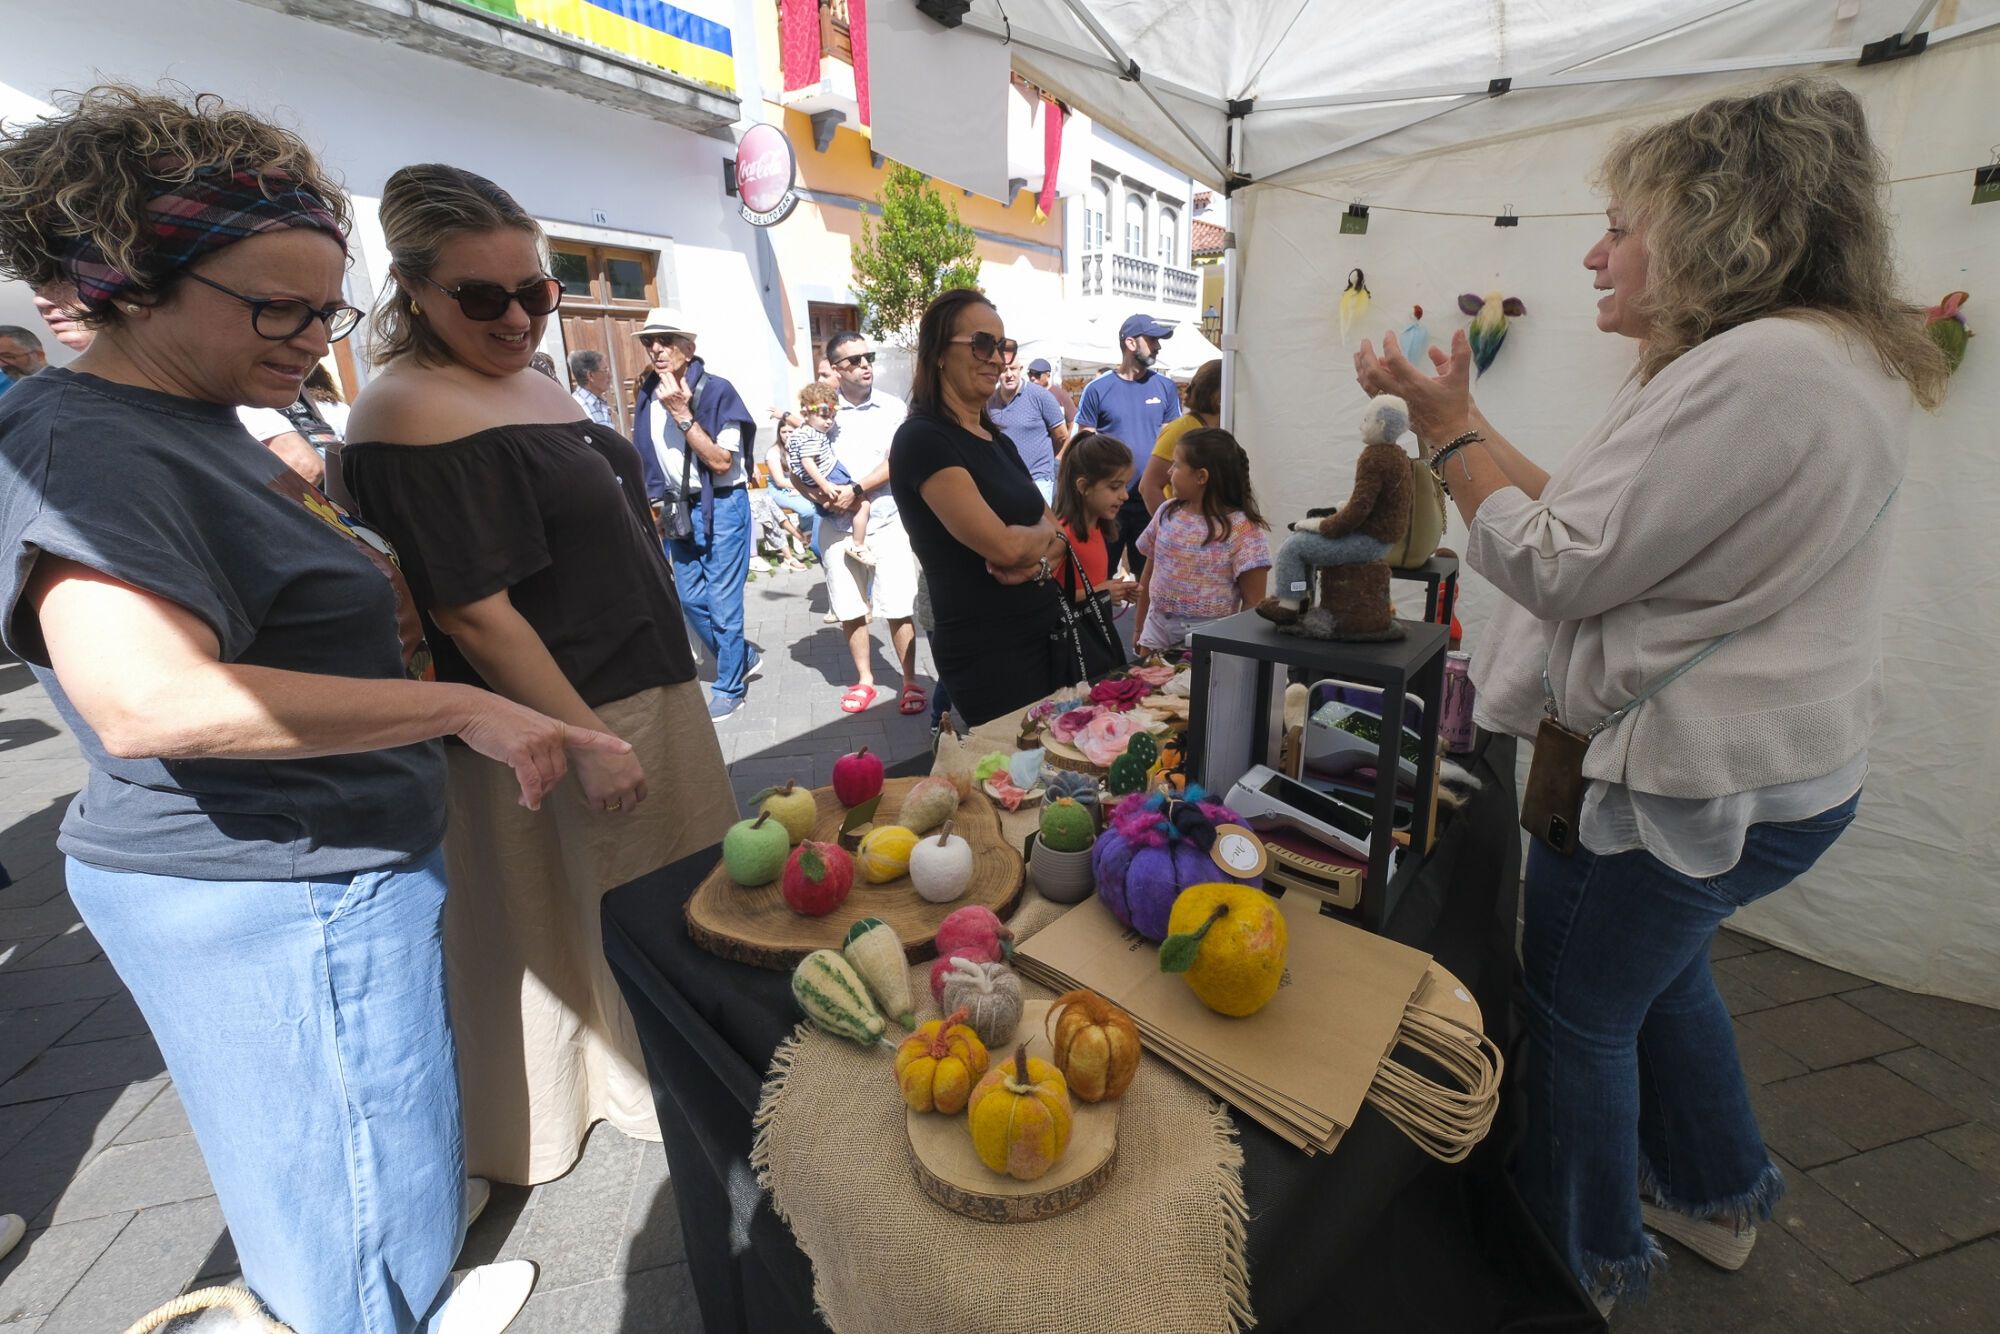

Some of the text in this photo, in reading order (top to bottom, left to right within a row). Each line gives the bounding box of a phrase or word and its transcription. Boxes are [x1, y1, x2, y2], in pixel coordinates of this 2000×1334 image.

[753, 214, 762, 224] DE
[762, 211, 778, 224] LITO
[778, 195, 791, 215] BAR
